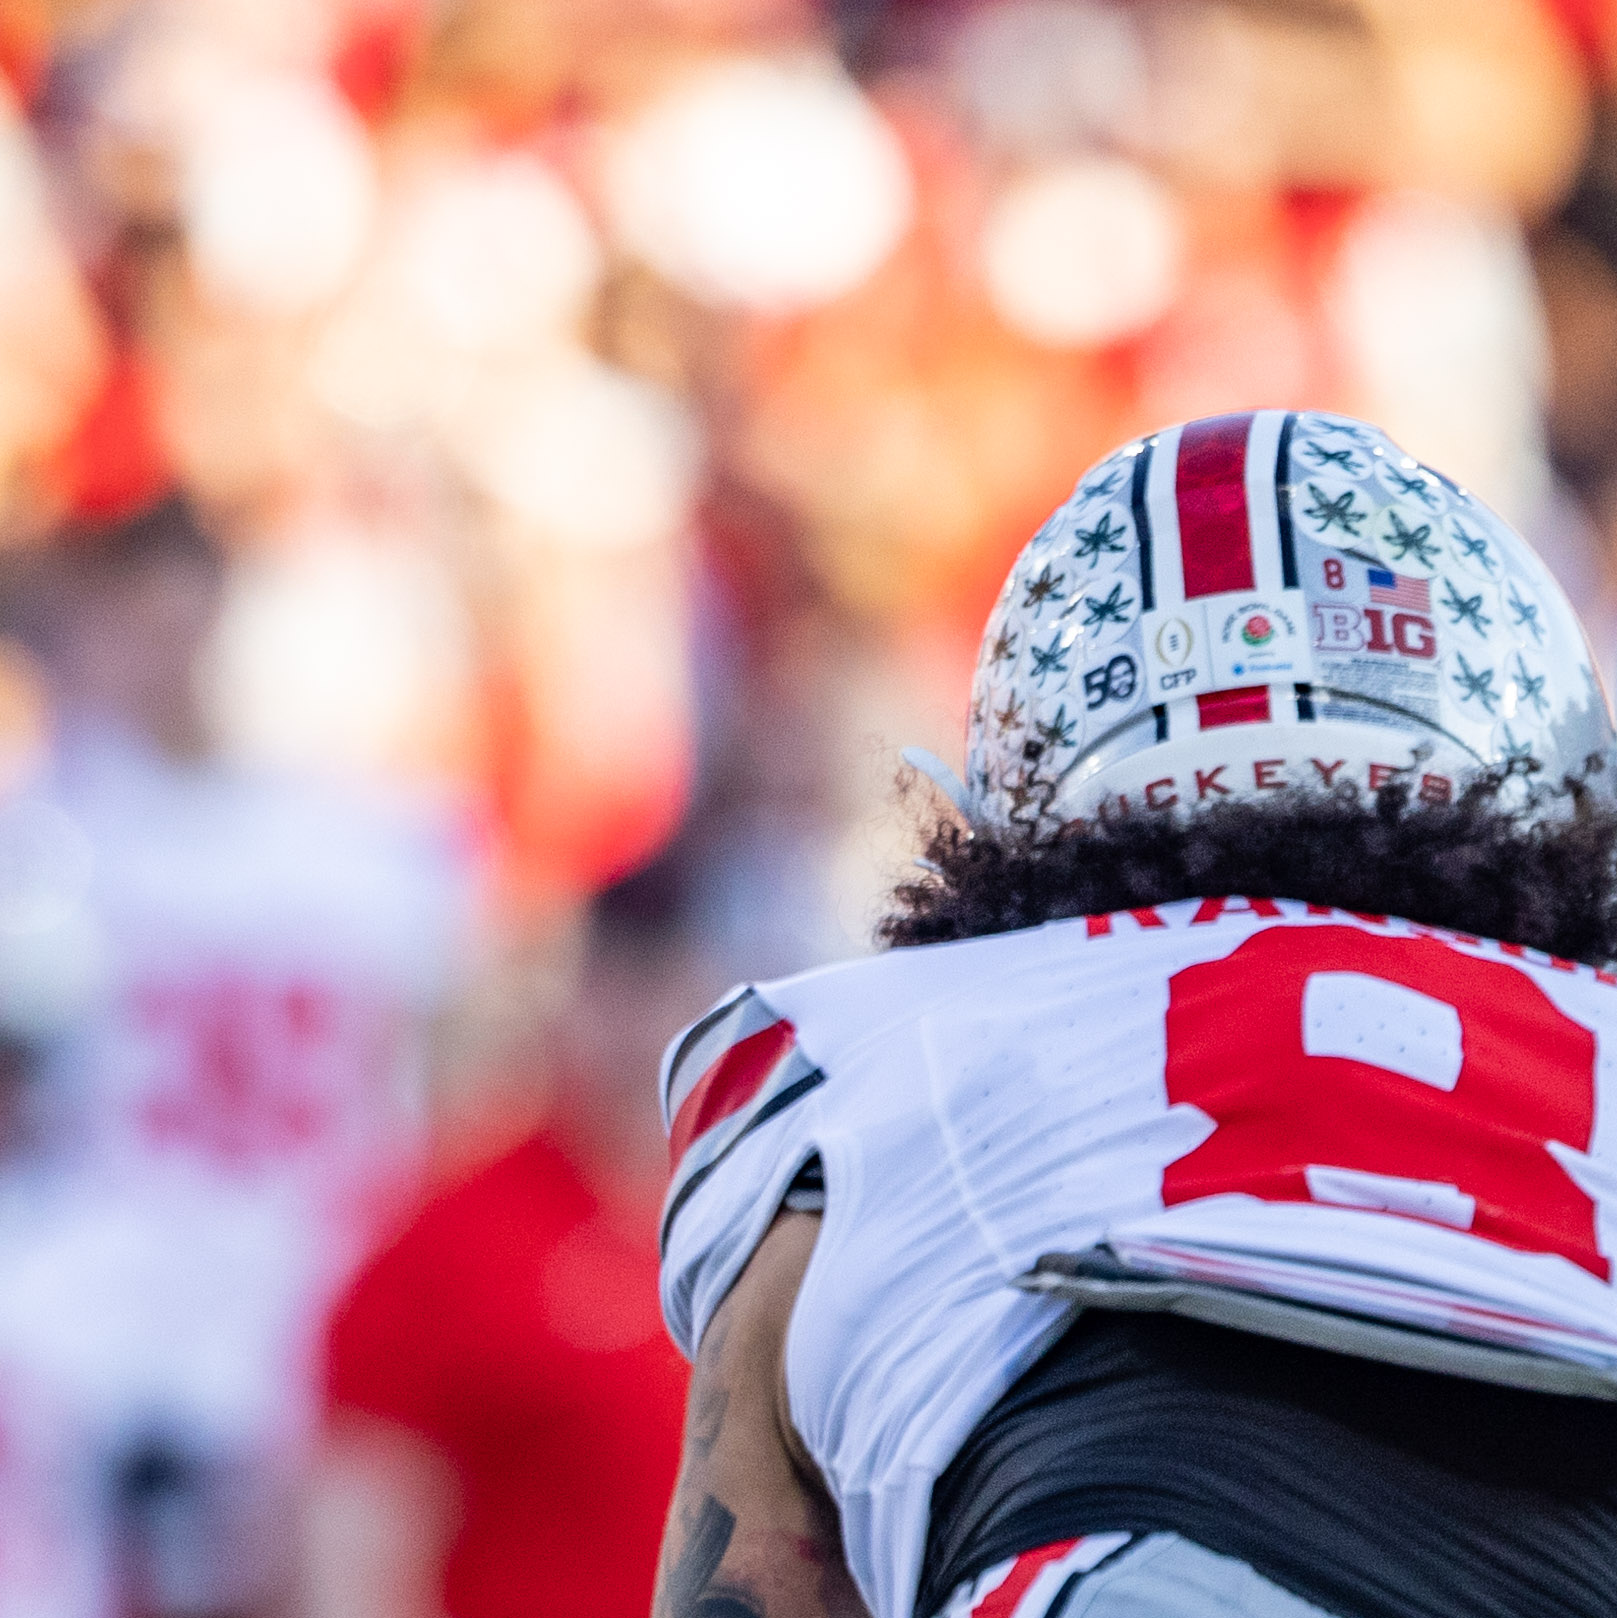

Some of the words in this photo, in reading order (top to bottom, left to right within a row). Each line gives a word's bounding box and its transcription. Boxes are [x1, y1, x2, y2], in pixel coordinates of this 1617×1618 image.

[1323, 558, 1346, 591] 8
[1160, 668, 1197, 691] CFP
[1162, 923, 1613, 1286] 8
